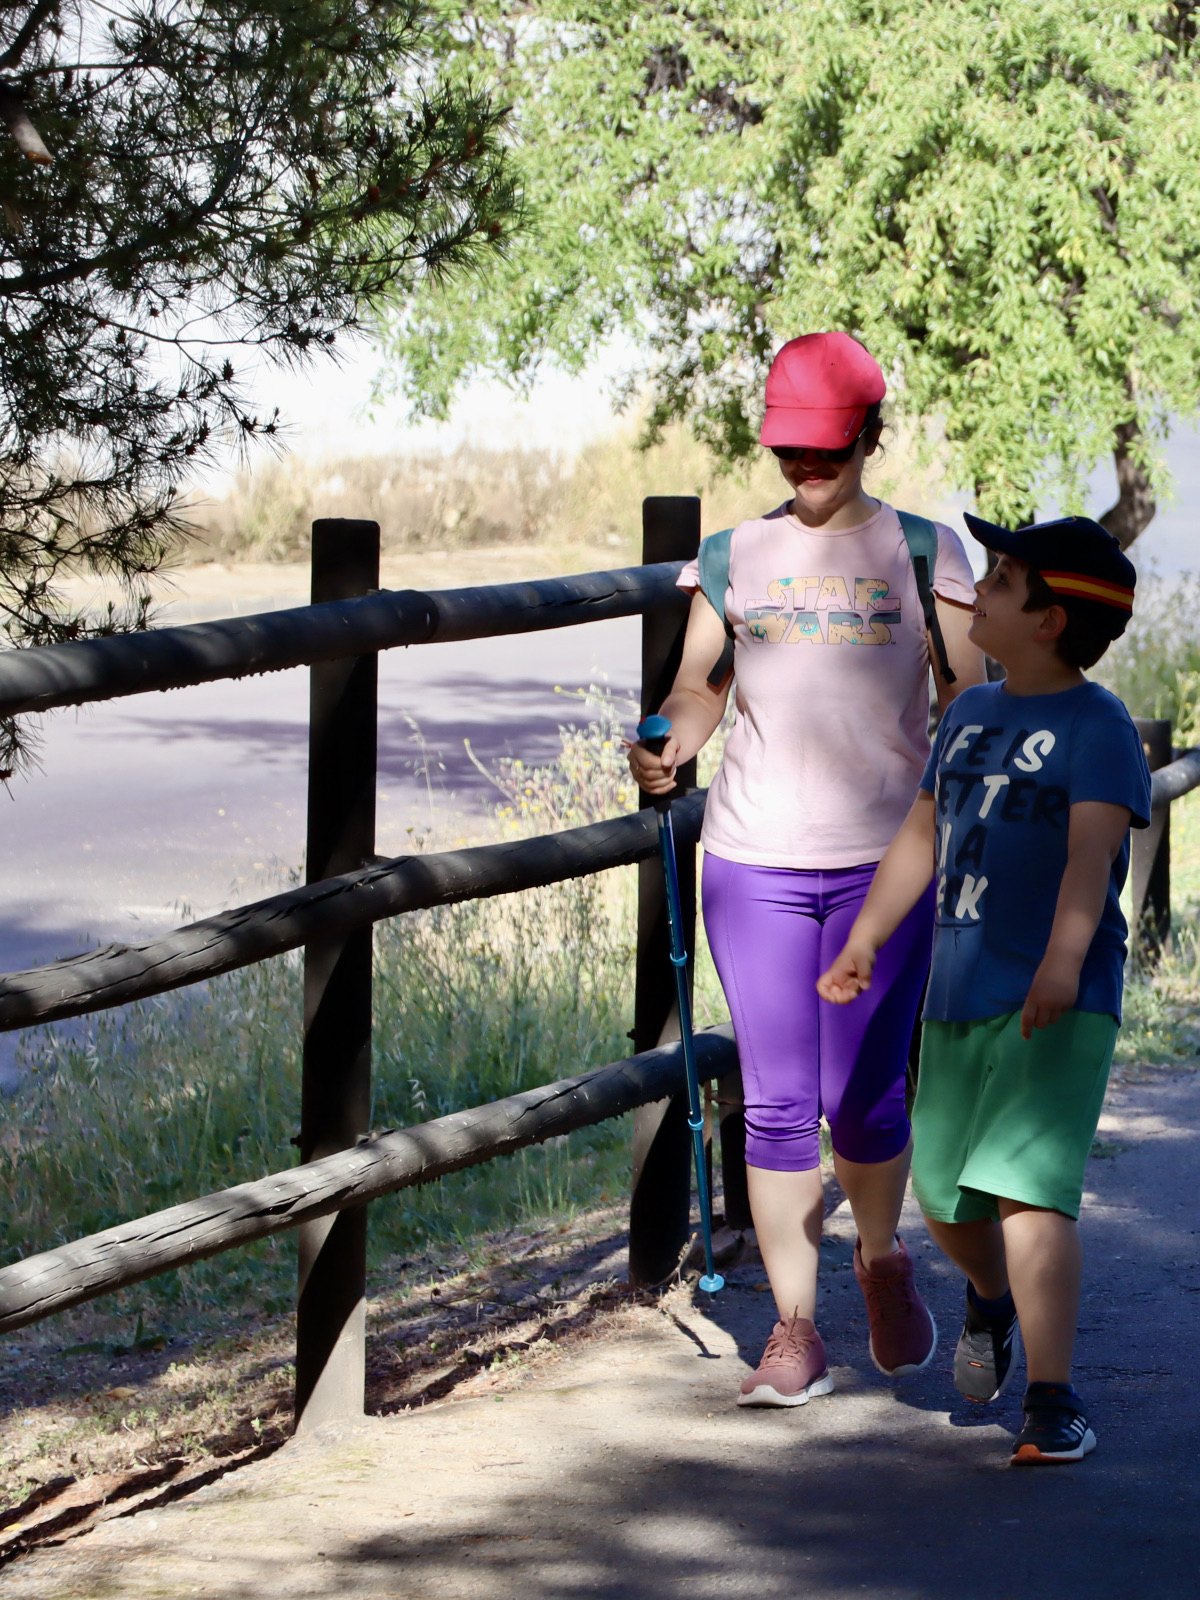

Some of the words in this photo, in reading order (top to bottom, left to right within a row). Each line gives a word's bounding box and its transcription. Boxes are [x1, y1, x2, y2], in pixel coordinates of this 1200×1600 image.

[744, 576, 902, 611] STAR
[744, 611, 902, 645] WARS
[1001, 729, 1056, 772] IS
[955, 824, 988, 871] A
